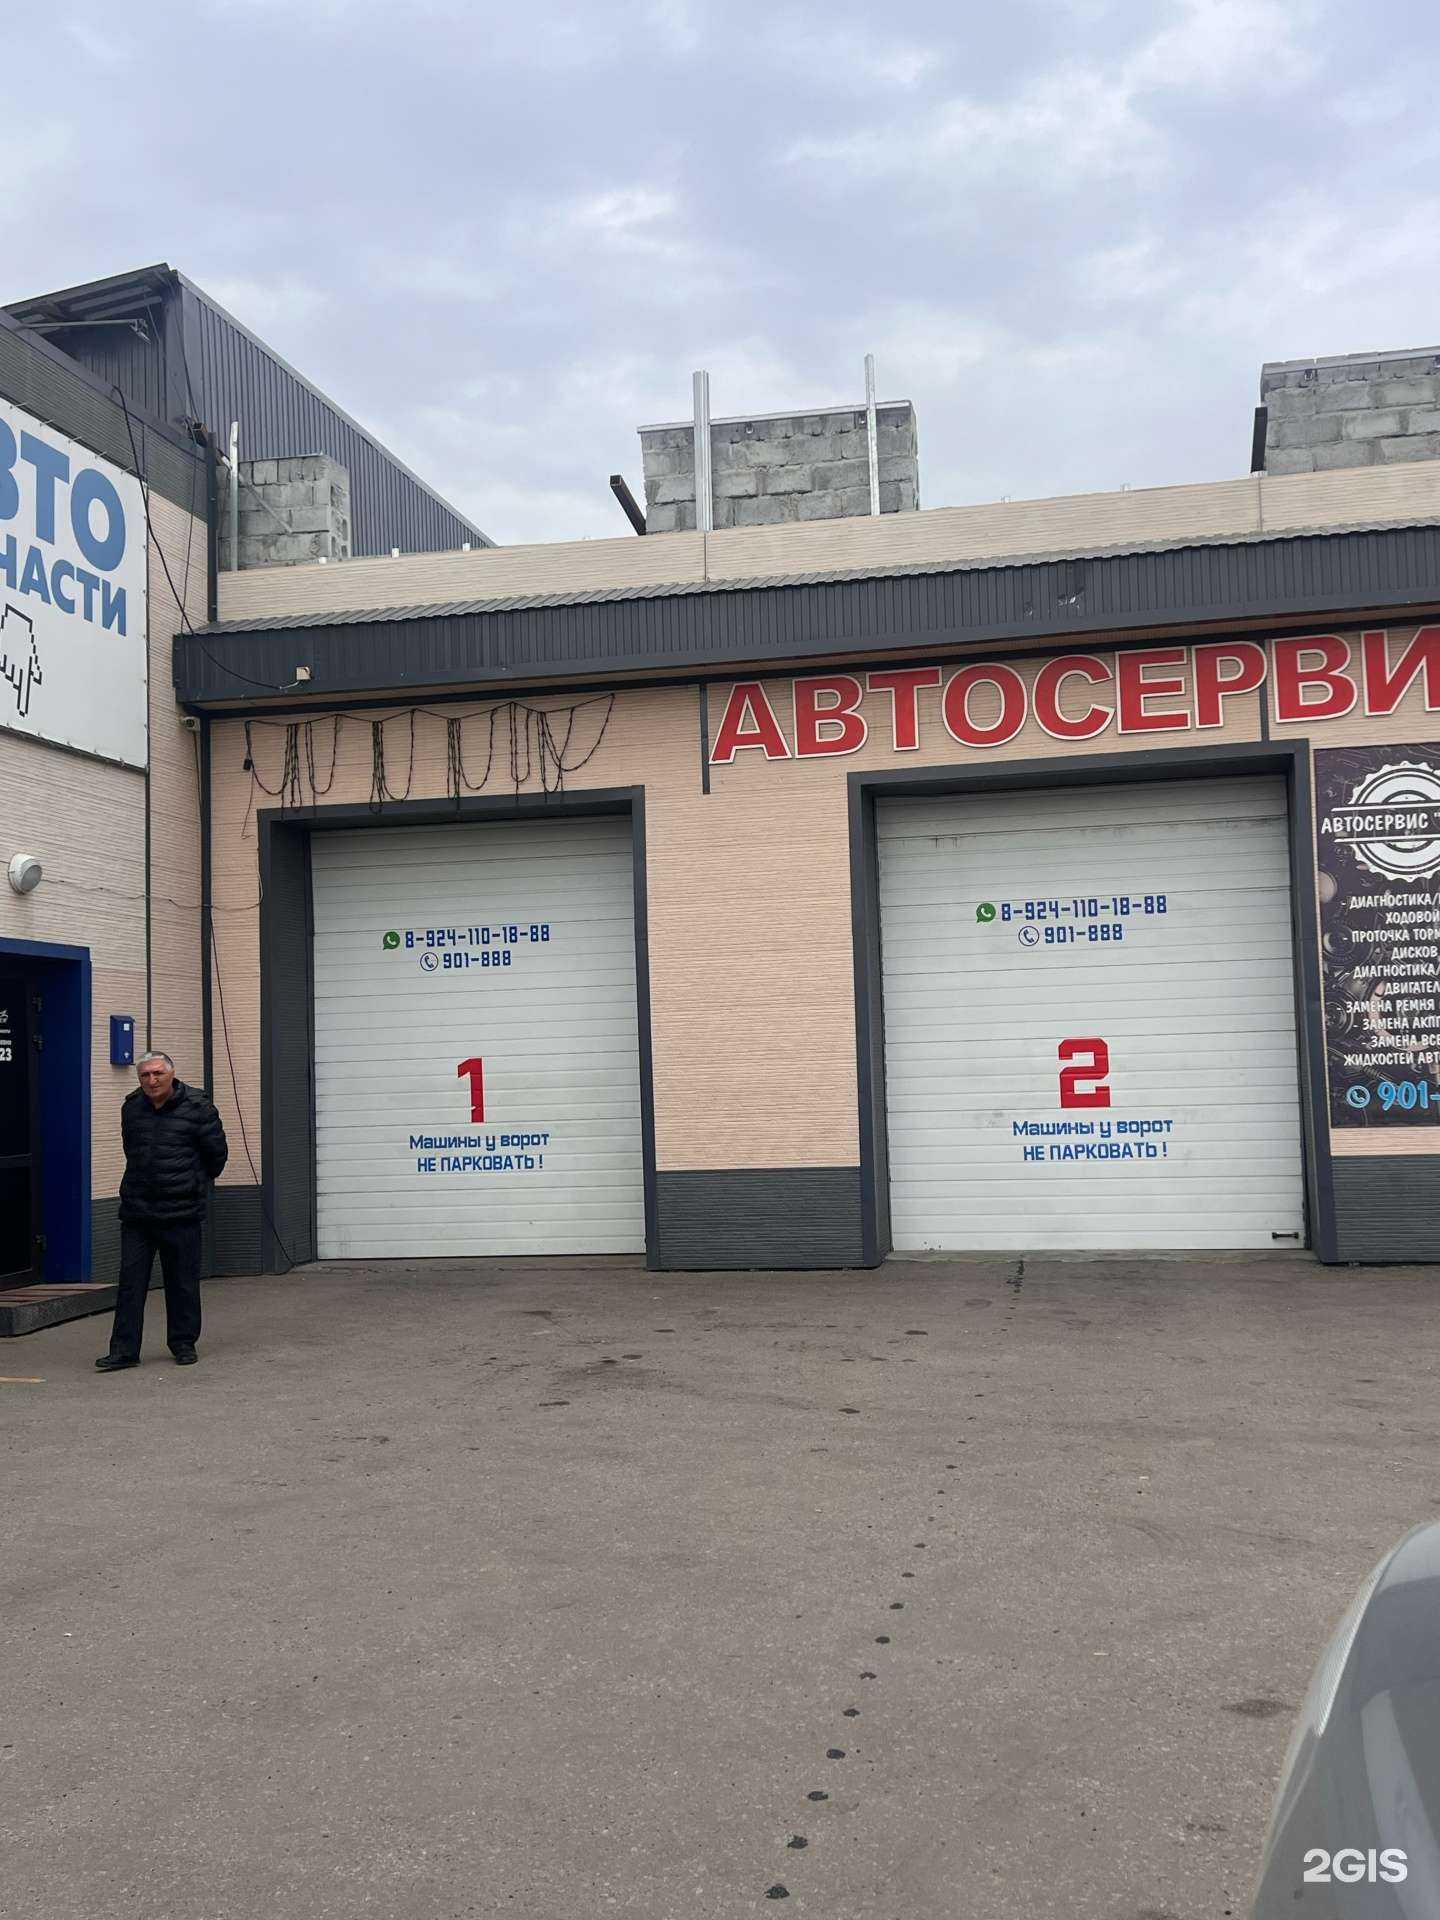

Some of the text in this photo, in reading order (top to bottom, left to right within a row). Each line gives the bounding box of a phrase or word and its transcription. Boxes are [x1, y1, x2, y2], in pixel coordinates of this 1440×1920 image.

[709, 625, 1440, 764] АВТОСЕРВИ
[1321, 813, 1429, 834] АВТОСЕРВИС
[1001, 895, 1167, 921] 8-924-110-18-88
[1350, 892, 1440, 909] ДИАГНОСТИКА/
[1385, 909, 1440, 925] ХОДОВОЙ
[406, 925, 550, 948] 8-924-110-18-88
[1044, 924, 1123, 944] 901-888
[1351, 929, 1410, 943] ПРОТОЧКА
[443, 951, 511, 969] 901-888
[1391, 945, 1438, 960] ДИСКОВ
[1346, 999, 1435, 1013] ЗАМЕНА РЕМНЯ
[1362, 1017, 1409, 1031] ЗАМЕНА
[1370, 1035, 1418, 1048] ЗАМЕНА
[1343, 1051, 1440, 1067] ЖИДКОСТЕЙ АВТ
[1057, 1037, 1111, 1108] 2
[457, 1057, 485, 1123] 1
[1013, 1120, 1173, 1138] Машины у ворот
[409, 1133, 549, 1151] Машины у ворот
[1024, 1145, 1044, 1160] НЕ
[418, 1157, 436, 1172] НЕ
